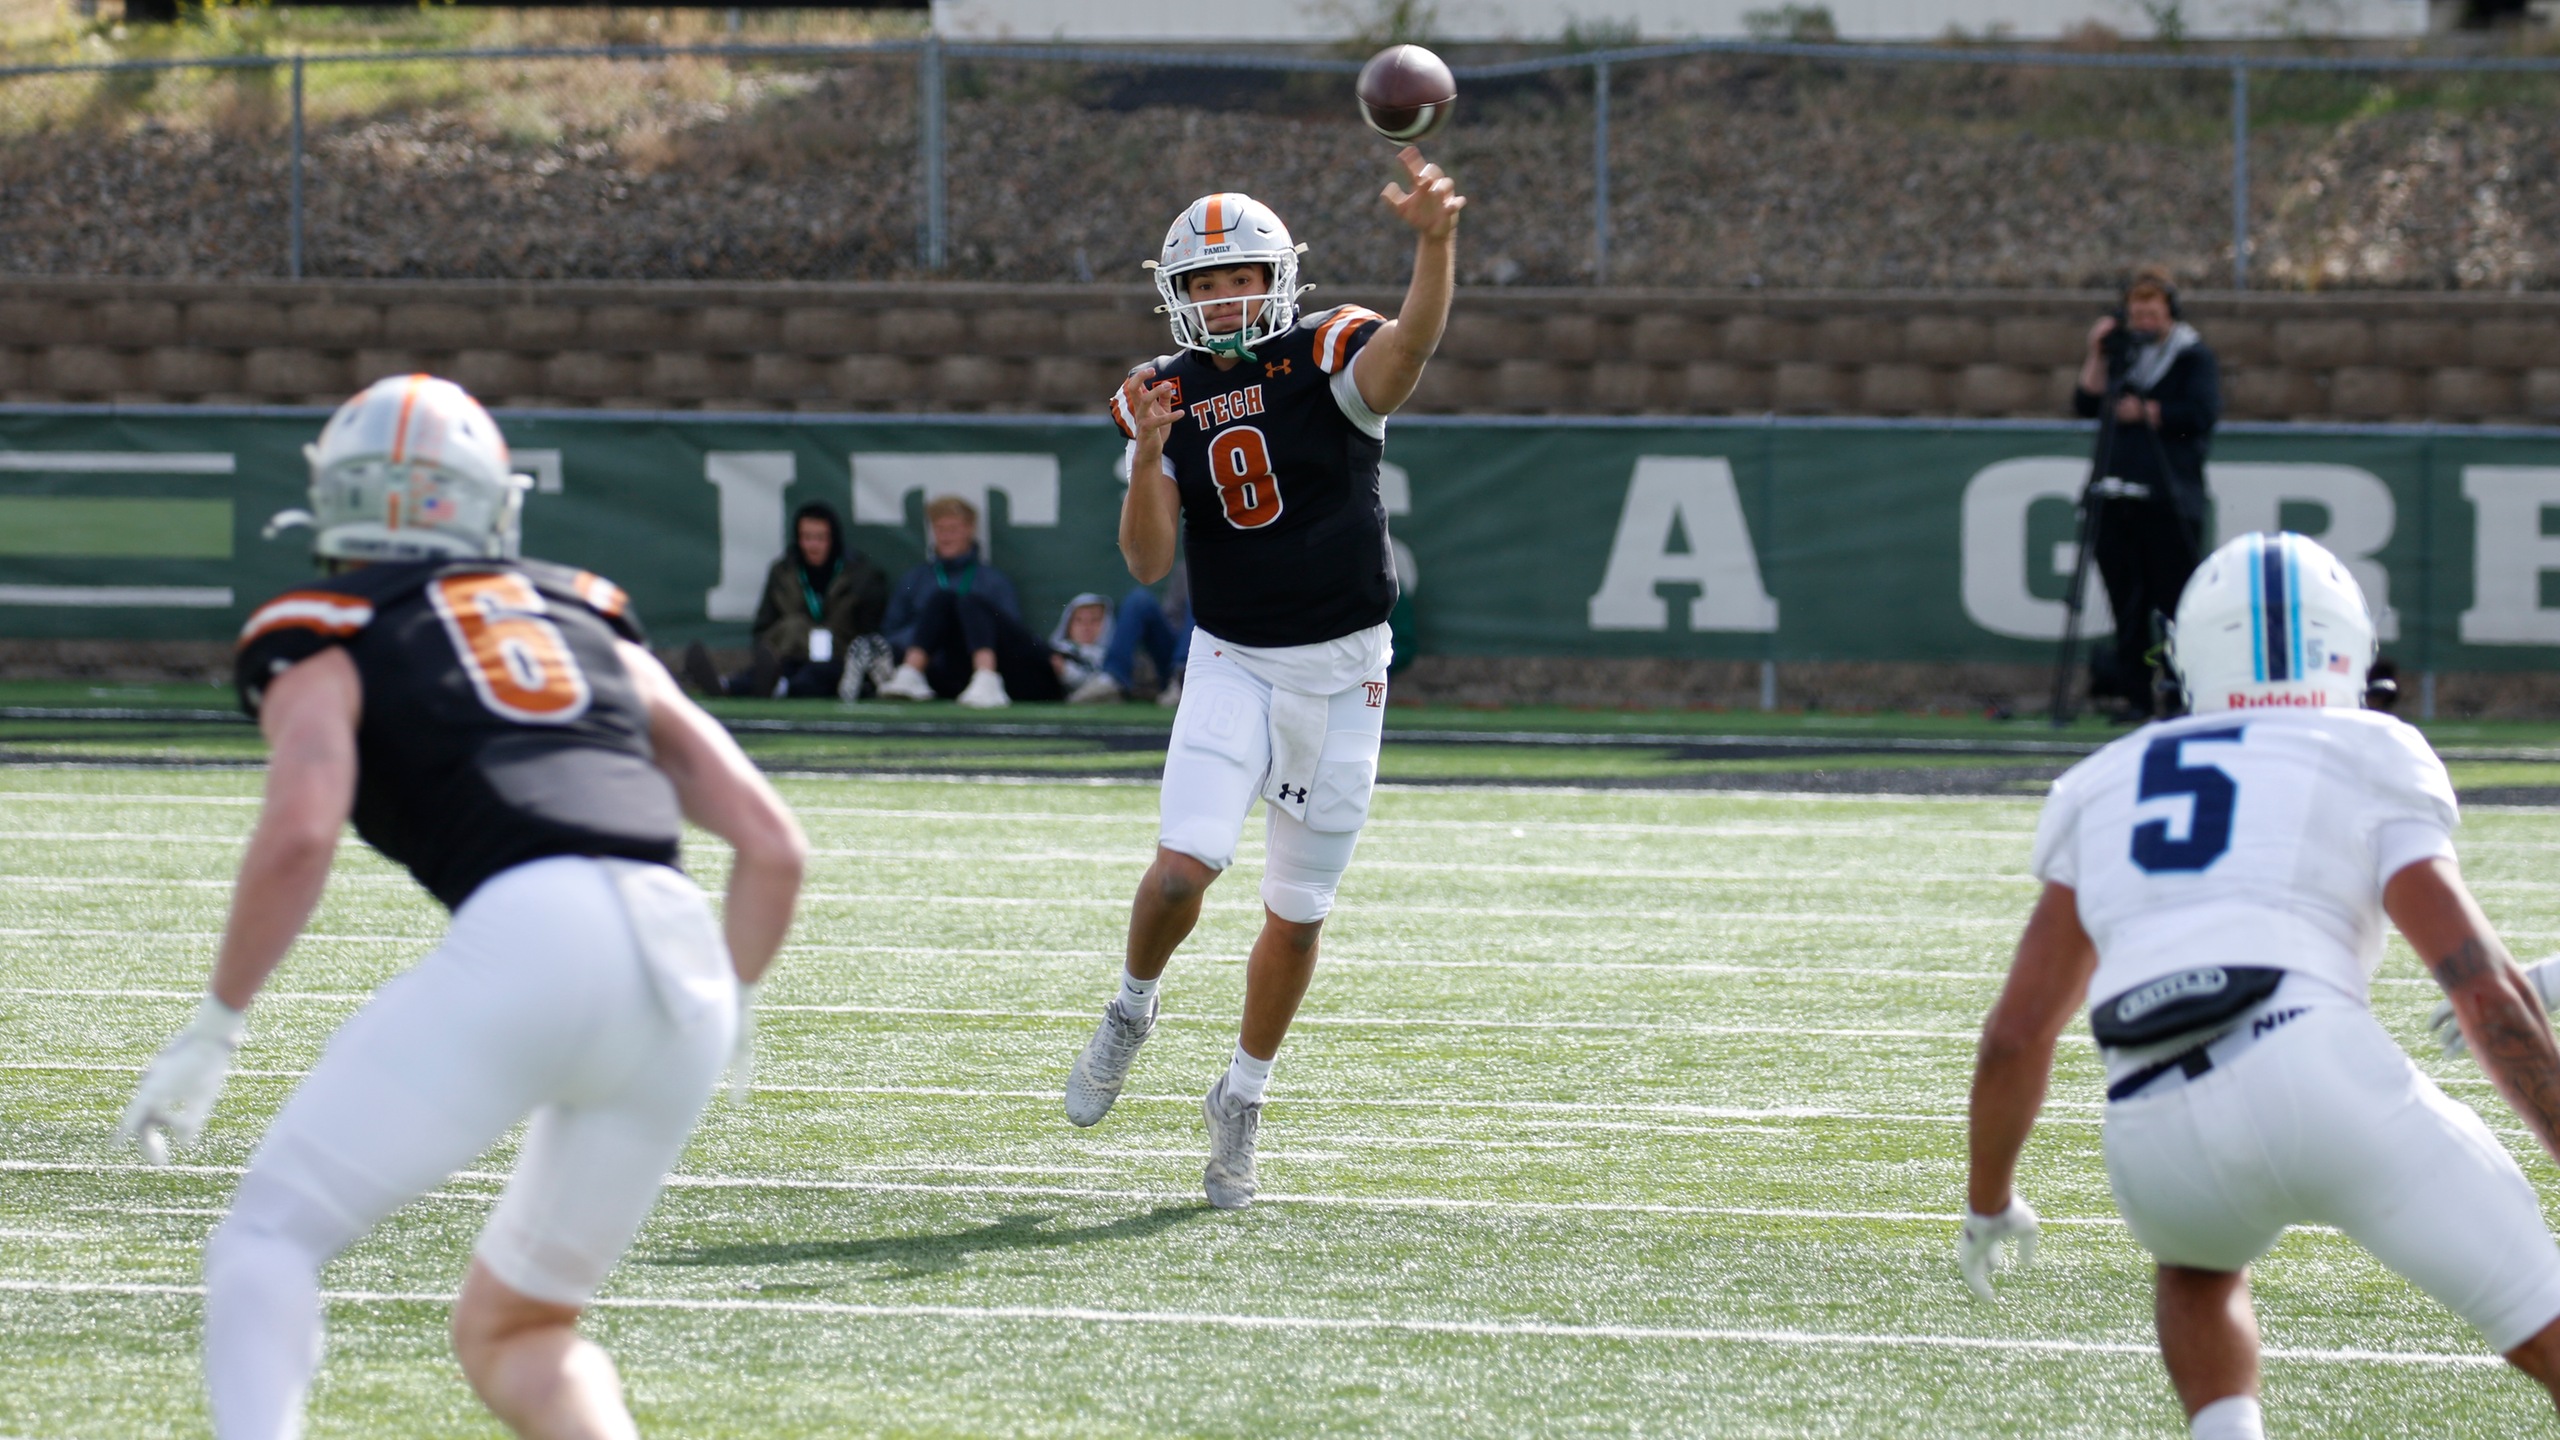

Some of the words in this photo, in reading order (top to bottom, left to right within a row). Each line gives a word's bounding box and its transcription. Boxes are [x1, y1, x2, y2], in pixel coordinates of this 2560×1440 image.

[1203, 245, 1231, 256] FAMILY
[1190, 385, 1265, 431] TECH
[1208, 425, 1284, 530] 8
[1588, 455, 1780, 634] A
[426, 572, 593, 725] 6
[2305, 638, 2324, 670] 5
[2128, 726, 2246, 876] 5
